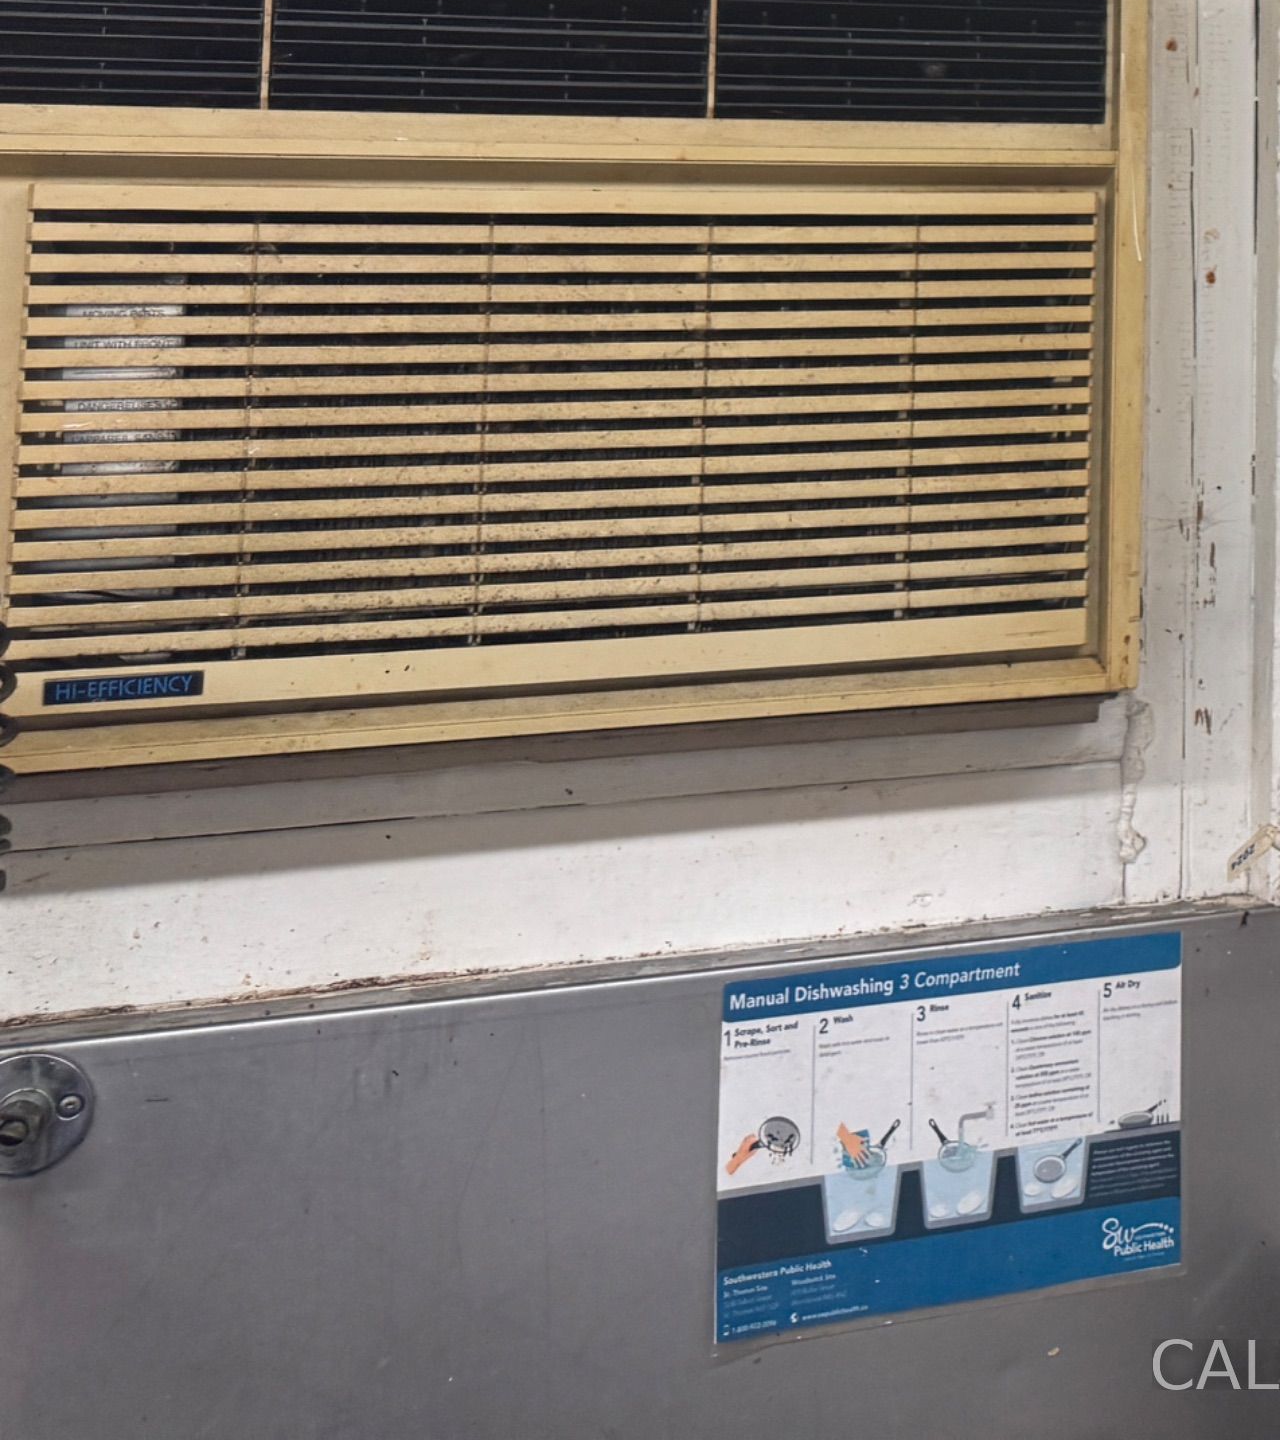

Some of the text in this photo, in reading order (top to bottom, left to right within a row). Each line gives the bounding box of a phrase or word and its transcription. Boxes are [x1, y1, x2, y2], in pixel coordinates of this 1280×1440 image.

[55, 675, 192, 700] HI-EFFICIENCY
[729, 962, 1020, 1010] Manual Dishwashing 3 Compartment
[1103, 980, 1140, 998] 5 Air Dry
[1012, 991, 1051, 1010] 4 Sanitize
[916, 1004, 949, 1022] 3 Rinse
[734, 1021, 798, 1037] Scrape, Sort and
[819, 1014, 853, 1034] 2 Wash
[724, 1030, 731, 1046] 1
[734, 1038, 770, 1048] Pre-Rinse
[1114, 1236, 1174, 1256] Public Health
[723, 1260, 832, 1286] Southwestern Public Health
